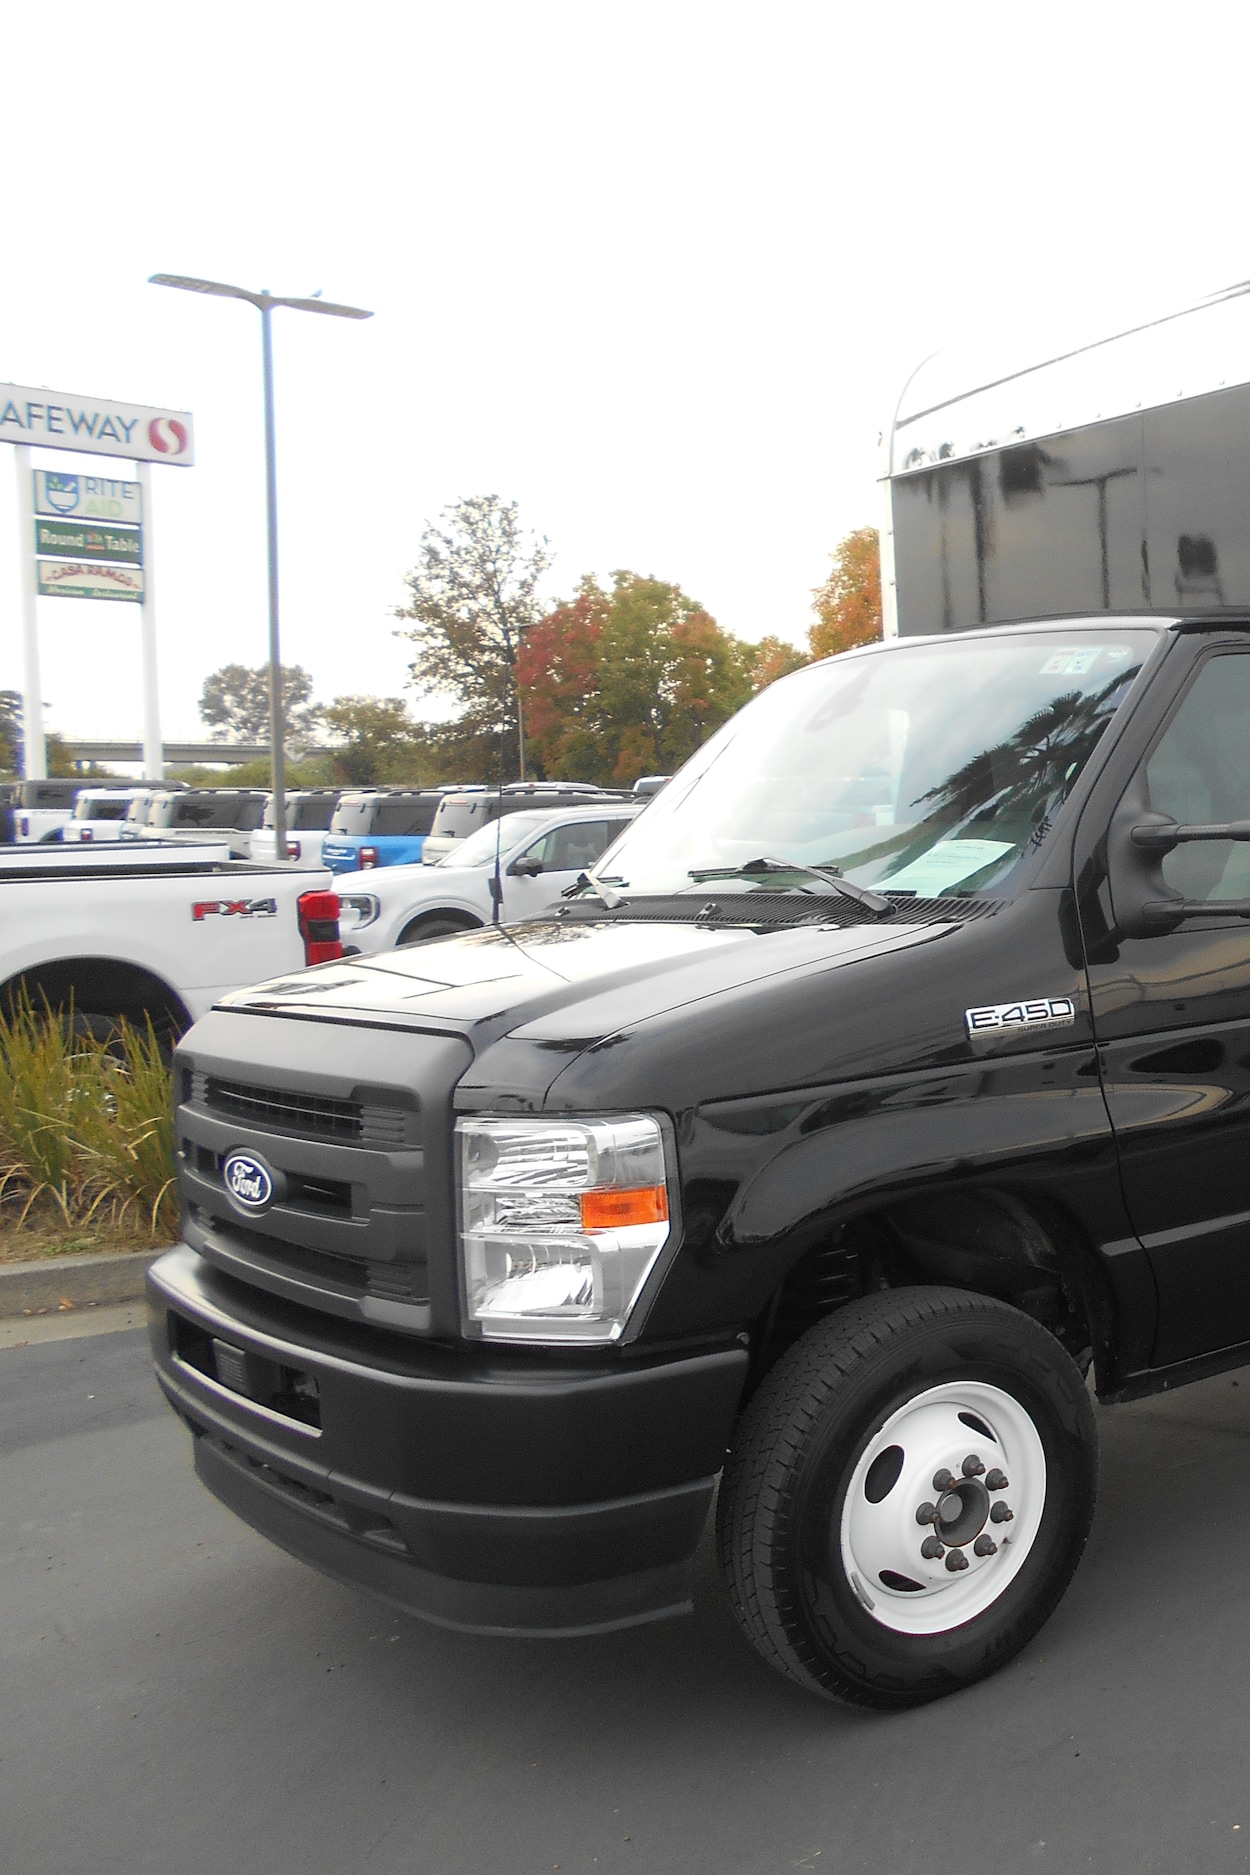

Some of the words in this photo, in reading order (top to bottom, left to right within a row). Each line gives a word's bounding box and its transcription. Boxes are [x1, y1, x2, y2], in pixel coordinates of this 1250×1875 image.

[0, 400, 139, 444] AFEWAY
[84, 477, 134, 500] RITE
[85, 500, 123, 517] AID
[40, 528, 84, 547] Round
[104, 534, 139, 553] Table
[191, 898, 277, 921] FX4
[970, 999, 1072, 1029] E-450
[1017, 1022, 1047, 1033] SUPER
[1048, 1019, 1071, 1029] DUTY
[232, 1161, 261, 1199] Ford
